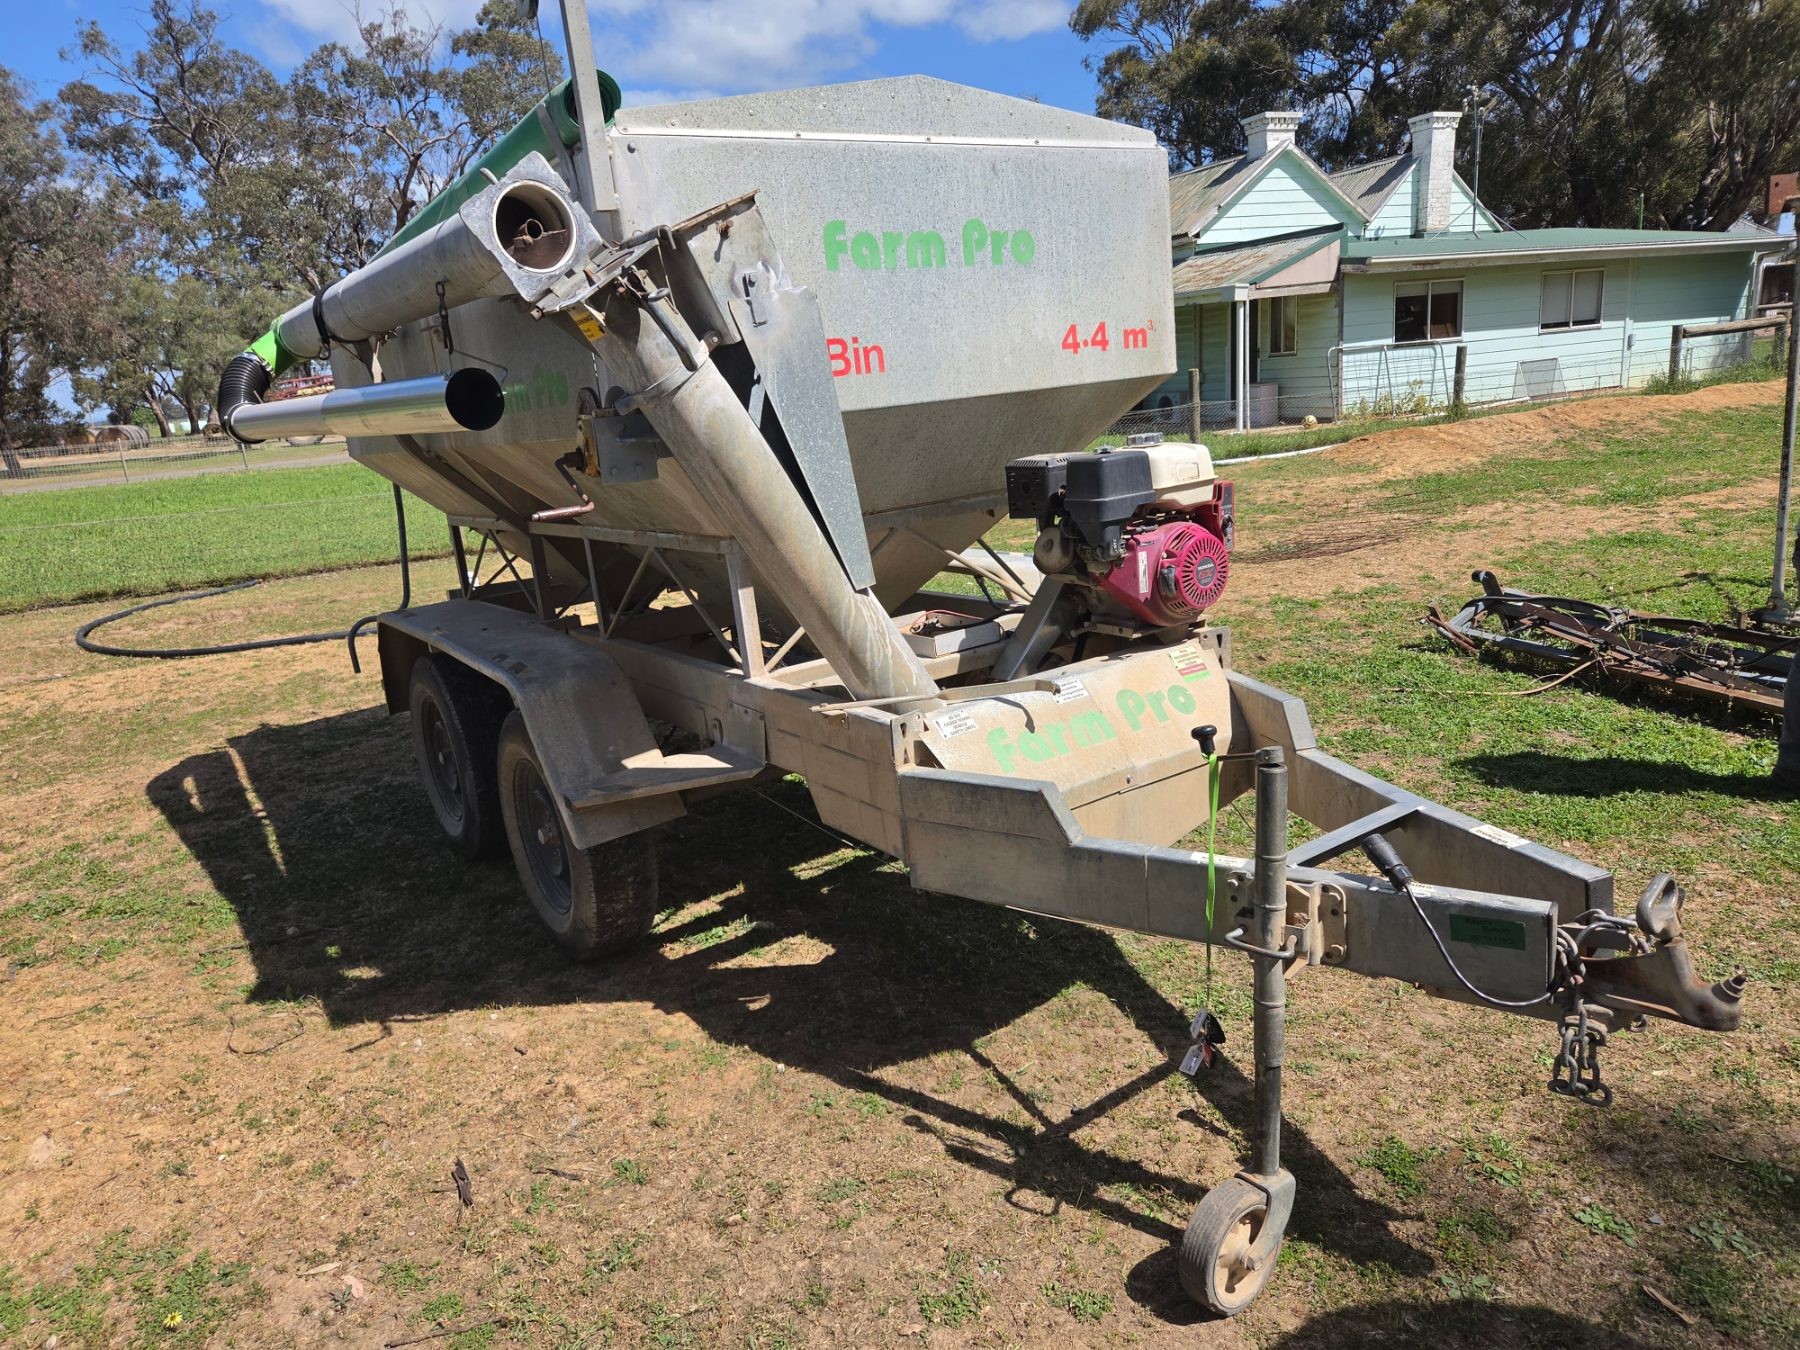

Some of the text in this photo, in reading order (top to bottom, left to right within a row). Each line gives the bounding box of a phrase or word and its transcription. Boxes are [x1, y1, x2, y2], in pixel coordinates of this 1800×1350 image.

[823, 218, 1036, 271] Farm Pro
[826, 336, 886, 378] Bin
[1061, 321, 1109, 355] 4.4
[987, 710, 1117, 773] Farm
[1115, 684, 1196, 731] Pro
